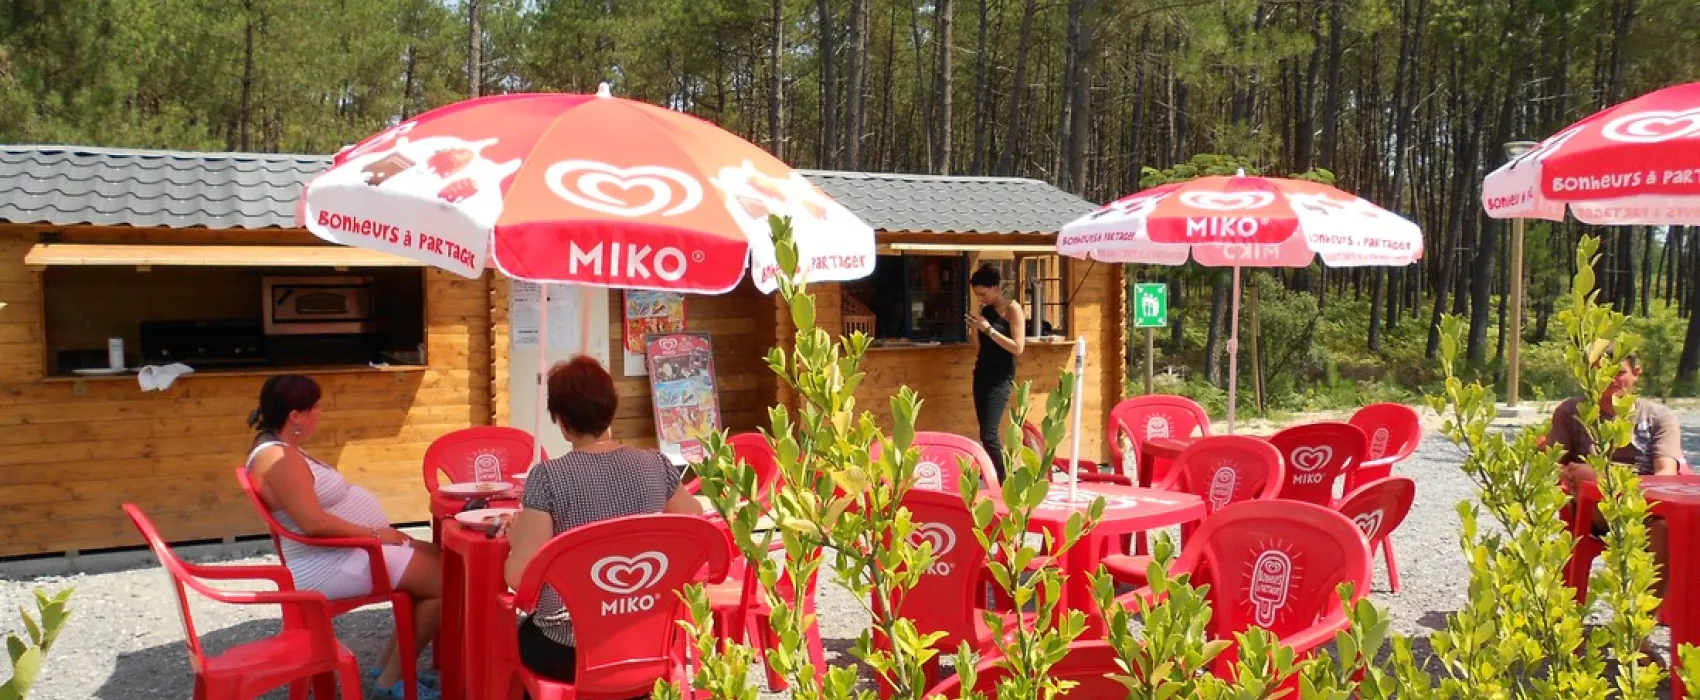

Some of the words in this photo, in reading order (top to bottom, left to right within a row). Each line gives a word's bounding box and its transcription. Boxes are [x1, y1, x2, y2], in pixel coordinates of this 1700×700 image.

[1186, 216, 1259, 237] MIKO
[403, 230, 412, 247] à
[569, 239, 688, 281] MIKO
[1292, 473, 1323, 485] MIKO
[601, 594, 655, 616] MIKO
